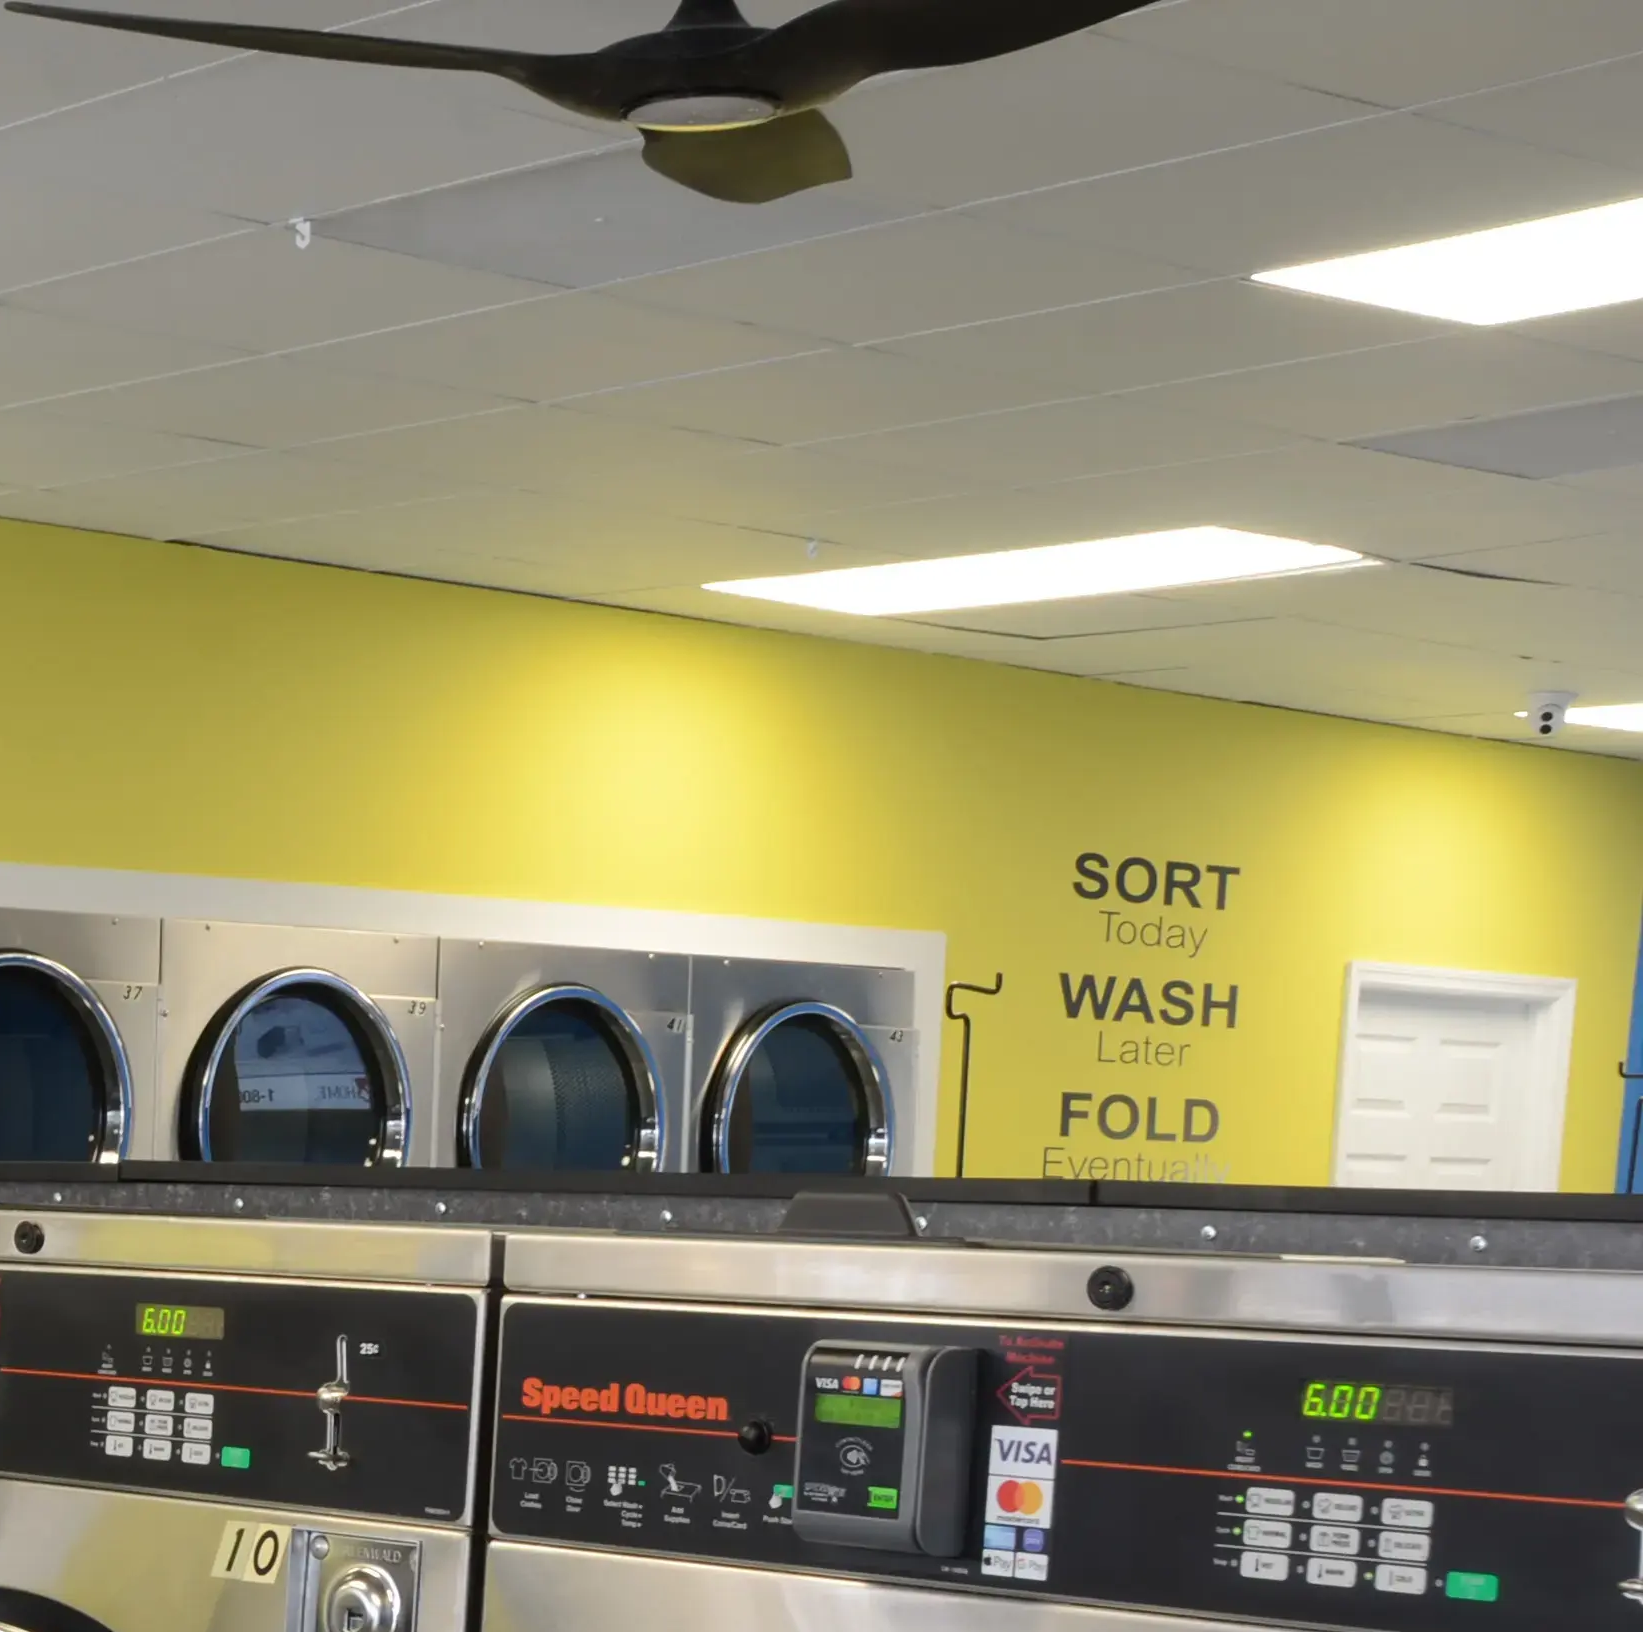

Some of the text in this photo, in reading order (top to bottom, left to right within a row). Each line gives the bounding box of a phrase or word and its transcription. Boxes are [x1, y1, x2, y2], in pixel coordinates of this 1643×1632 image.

[1072, 852, 1240, 911] SORT
[1098, 910, 1208, 957] Today
[122, 985, 143, 1000] 37
[1059, 972, 1238, 1029] WASH
[407, 1000, 426, 1015] 39
[666, 1017, 682, 1031] 41
[1097, 1031, 1191, 1068] Later
[1059, 1092, 1220, 1143] FOLD
[142, 1307, 186, 1335] 6.00
[359, 1342, 379, 1355] 25¢
[999, 1335, 1014, 1346] To
[815, 1376, 839, 1389] VISA
[1011, 1381, 1056, 1396] Swipe or
[522, 1377, 729, 1421] Speed Queen
[1009, 1394, 1055, 1409] Tap Here
[1302, 1383, 1381, 1420] 6.00
[994, 1438, 1053, 1466] VISA
[225, 1528, 279, 1576] 10
[993, 1555, 1013, 1571] Pay
[1028, 1559, 1049, 1574] Pay
